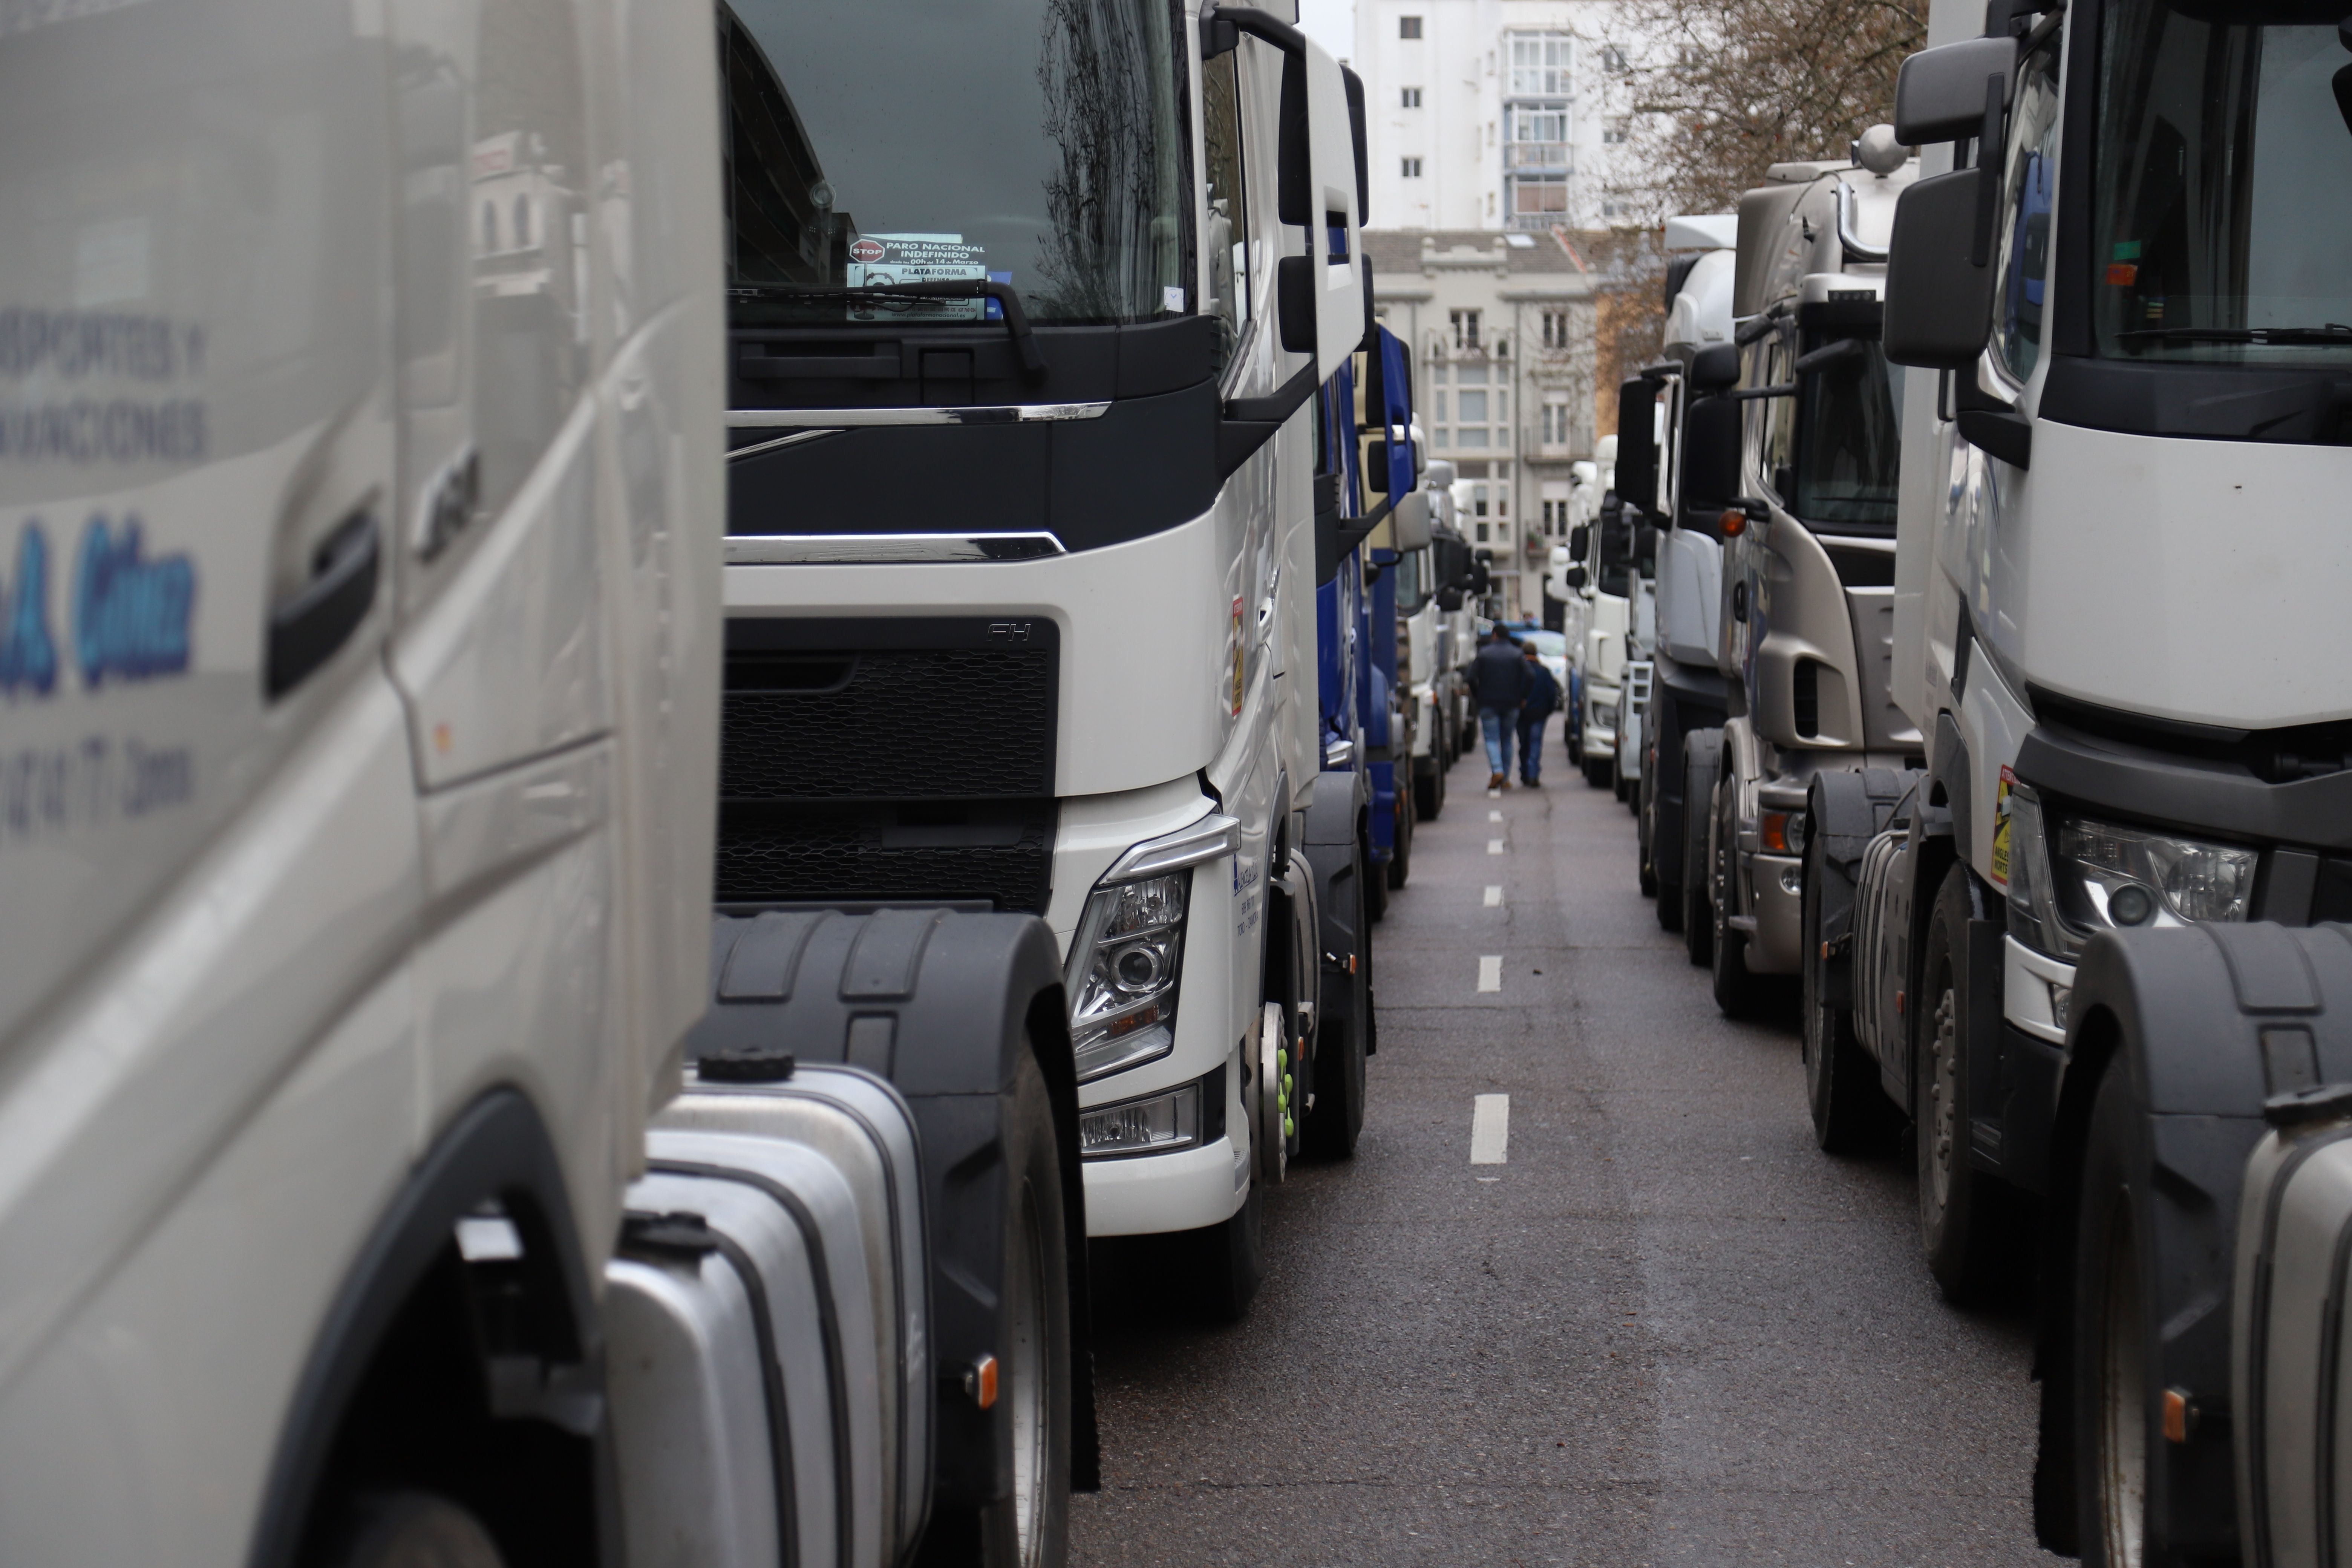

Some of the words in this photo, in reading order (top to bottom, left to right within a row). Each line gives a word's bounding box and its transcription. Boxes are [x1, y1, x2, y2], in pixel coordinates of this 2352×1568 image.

[922, 243, 985, 253] NACIONAL
[900, 250, 969, 259] INDEFINIDO
[986, 623, 1031, 642] FH
